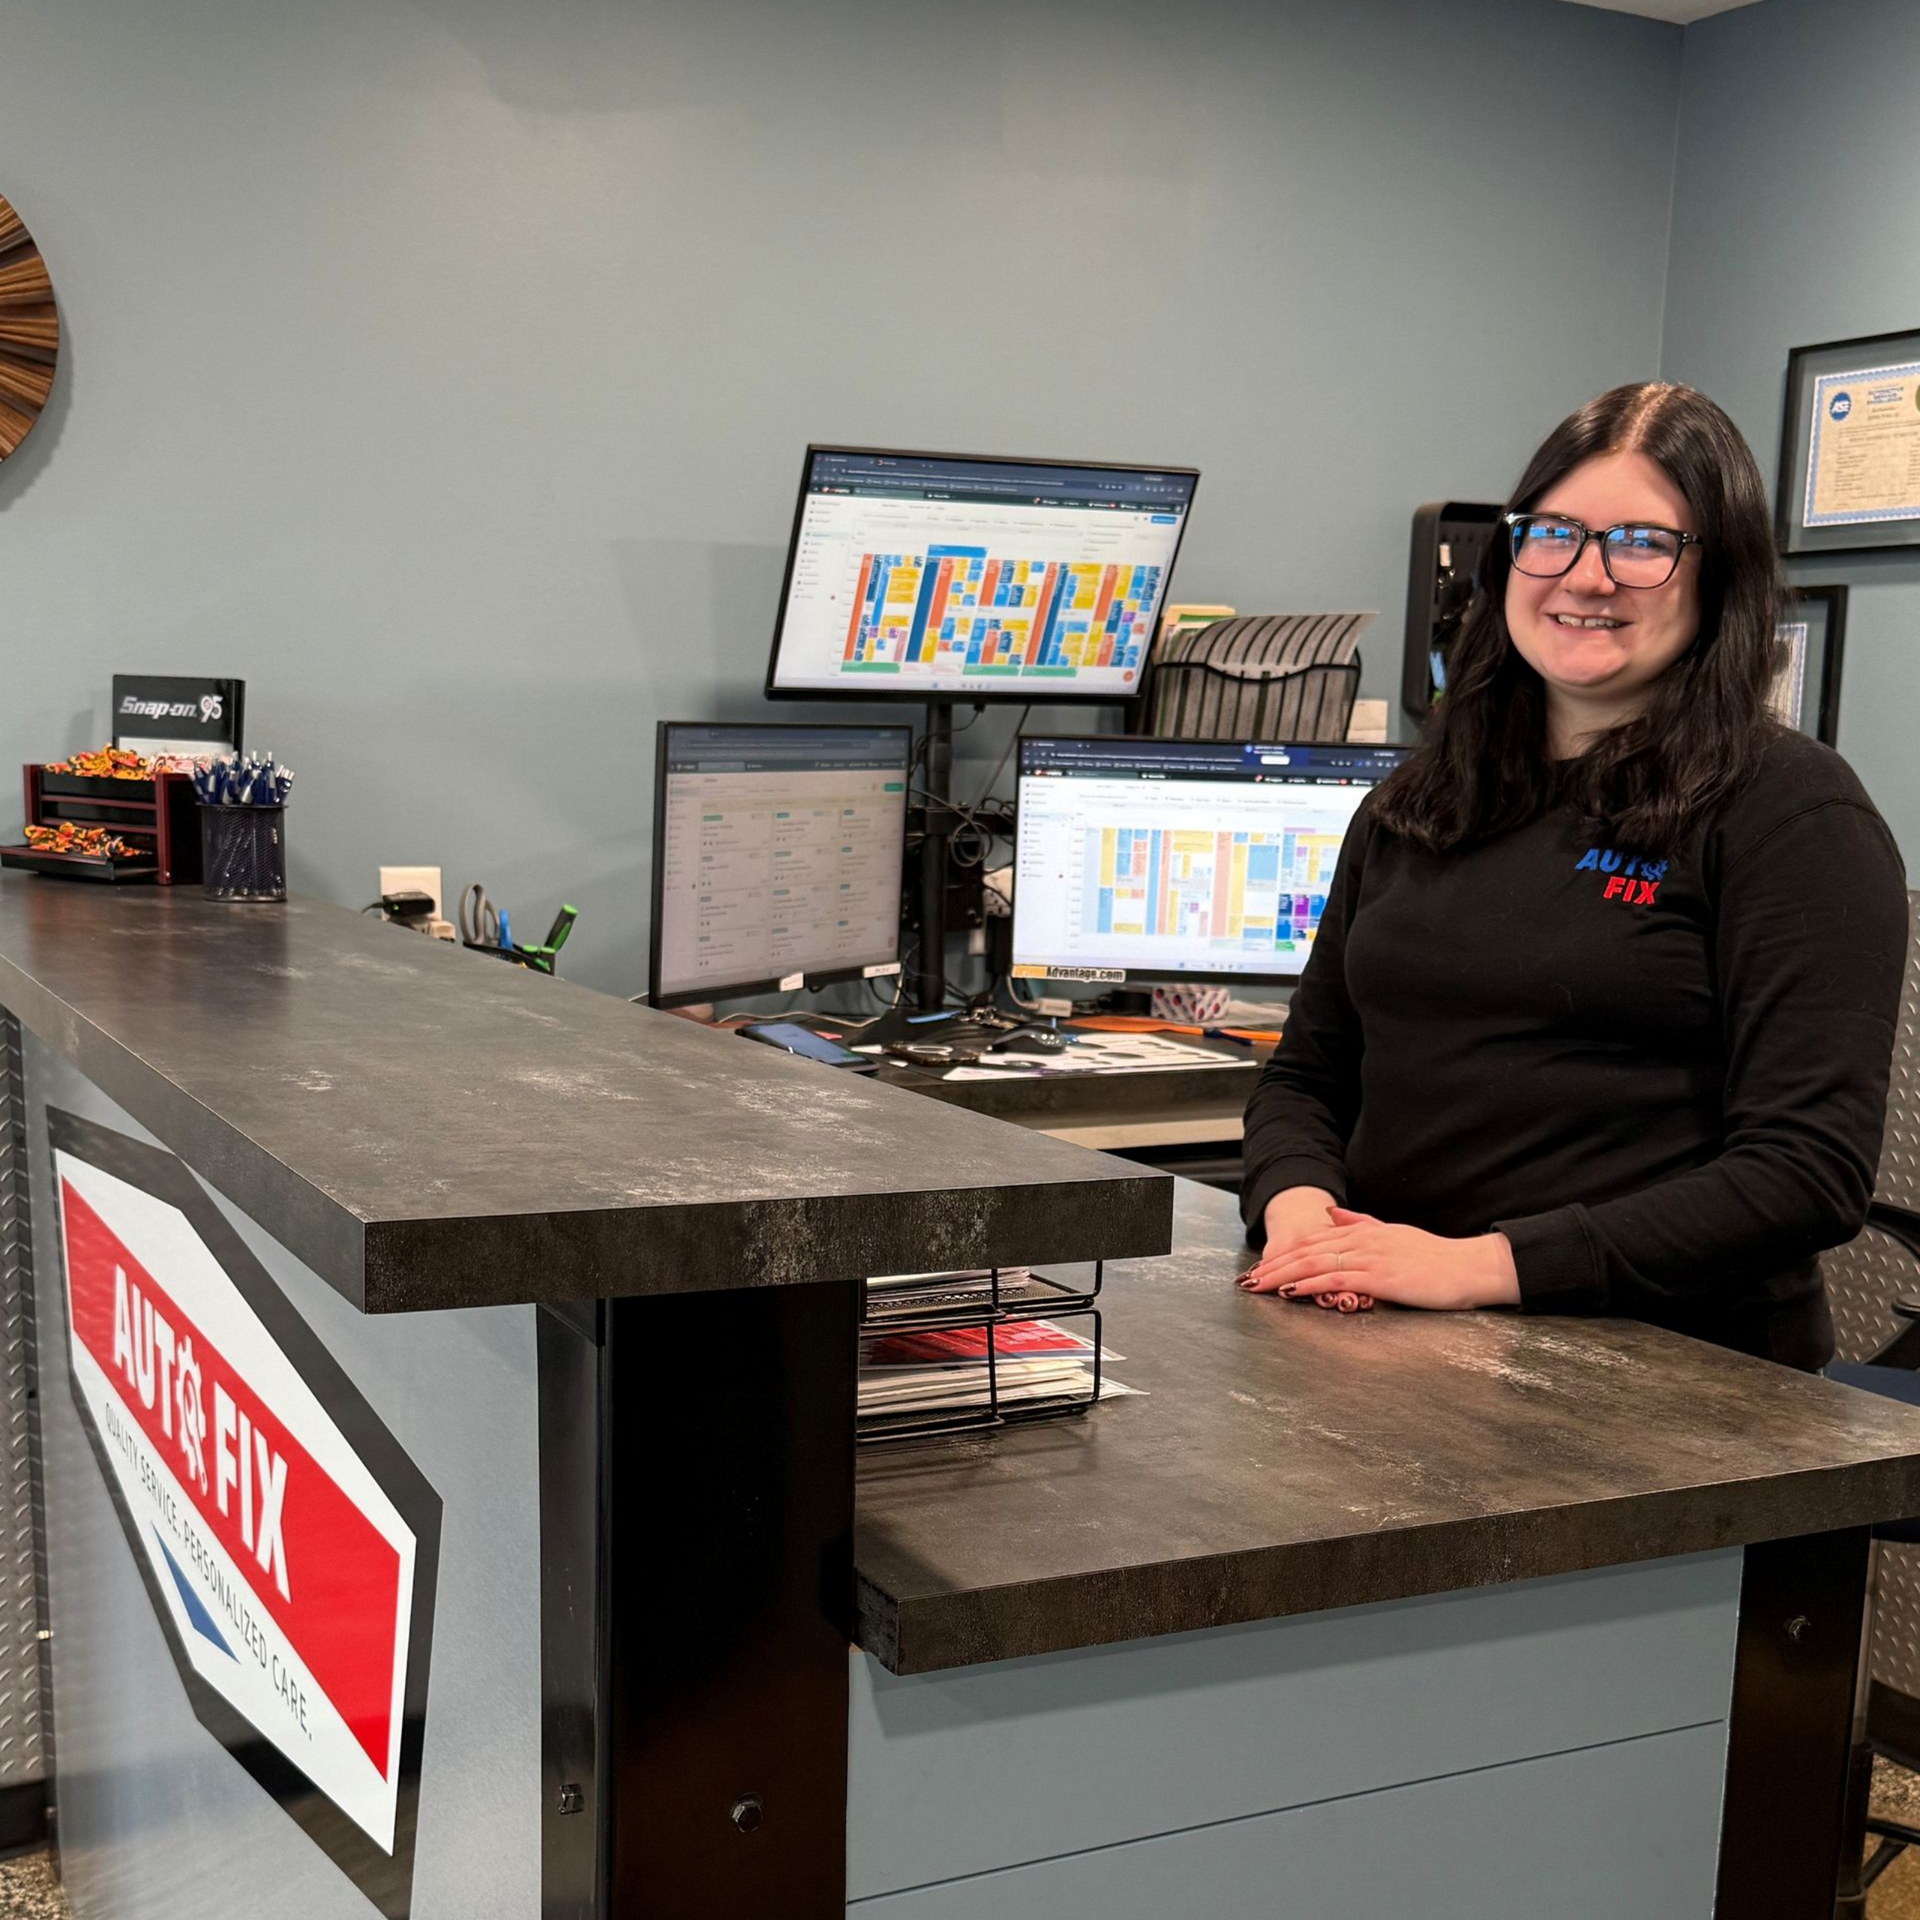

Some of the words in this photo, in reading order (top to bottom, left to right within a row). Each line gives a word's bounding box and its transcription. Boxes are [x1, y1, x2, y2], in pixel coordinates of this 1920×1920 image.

[119, 696, 197, 719] Snap-on
[200, 694, 223, 723] 95
[1603, 876, 1660, 905] FIX
[1046, 966, 1124, 981] Advantage.com
[113, 1263, 208, 1497] AUTO
[213, 1379, 291, 1604] FIX
[104, 1402, 138, 1466] QUALITY
[184, 1519, 267, 1669] PERSONALIZED
[272, 1654, 312, 1741] CARE.
